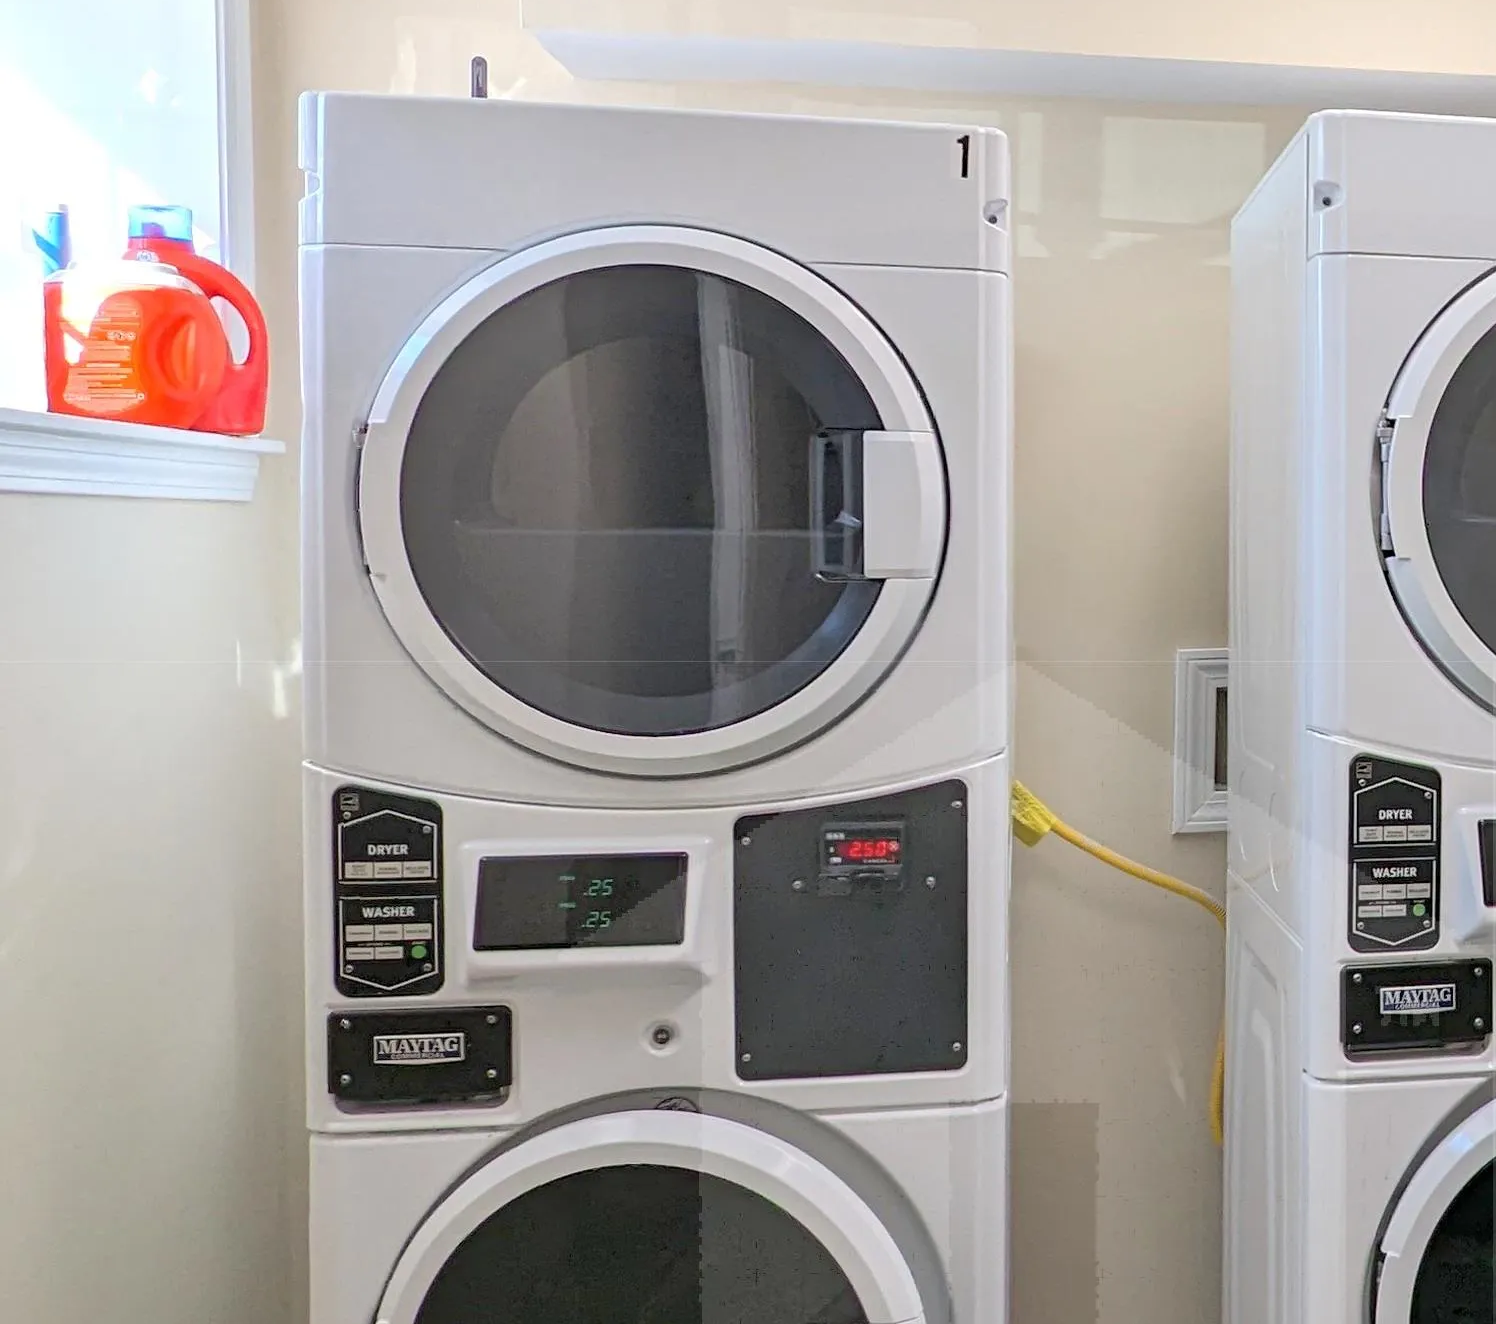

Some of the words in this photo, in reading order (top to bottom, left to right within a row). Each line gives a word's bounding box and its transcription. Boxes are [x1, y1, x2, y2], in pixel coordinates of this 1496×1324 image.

[956, 134, 970, 179] 1
[1378, 809, 1413, 821] DRYER
[367, 844, 409, 856] DRYER
[1372, 866, 1418, 879] WASHER
[362, 906, 415, 918] WASHER
[1384, 988, 1452, 1006] MAYTAG
[378, 1037, 459, 1055] MAYTAG
